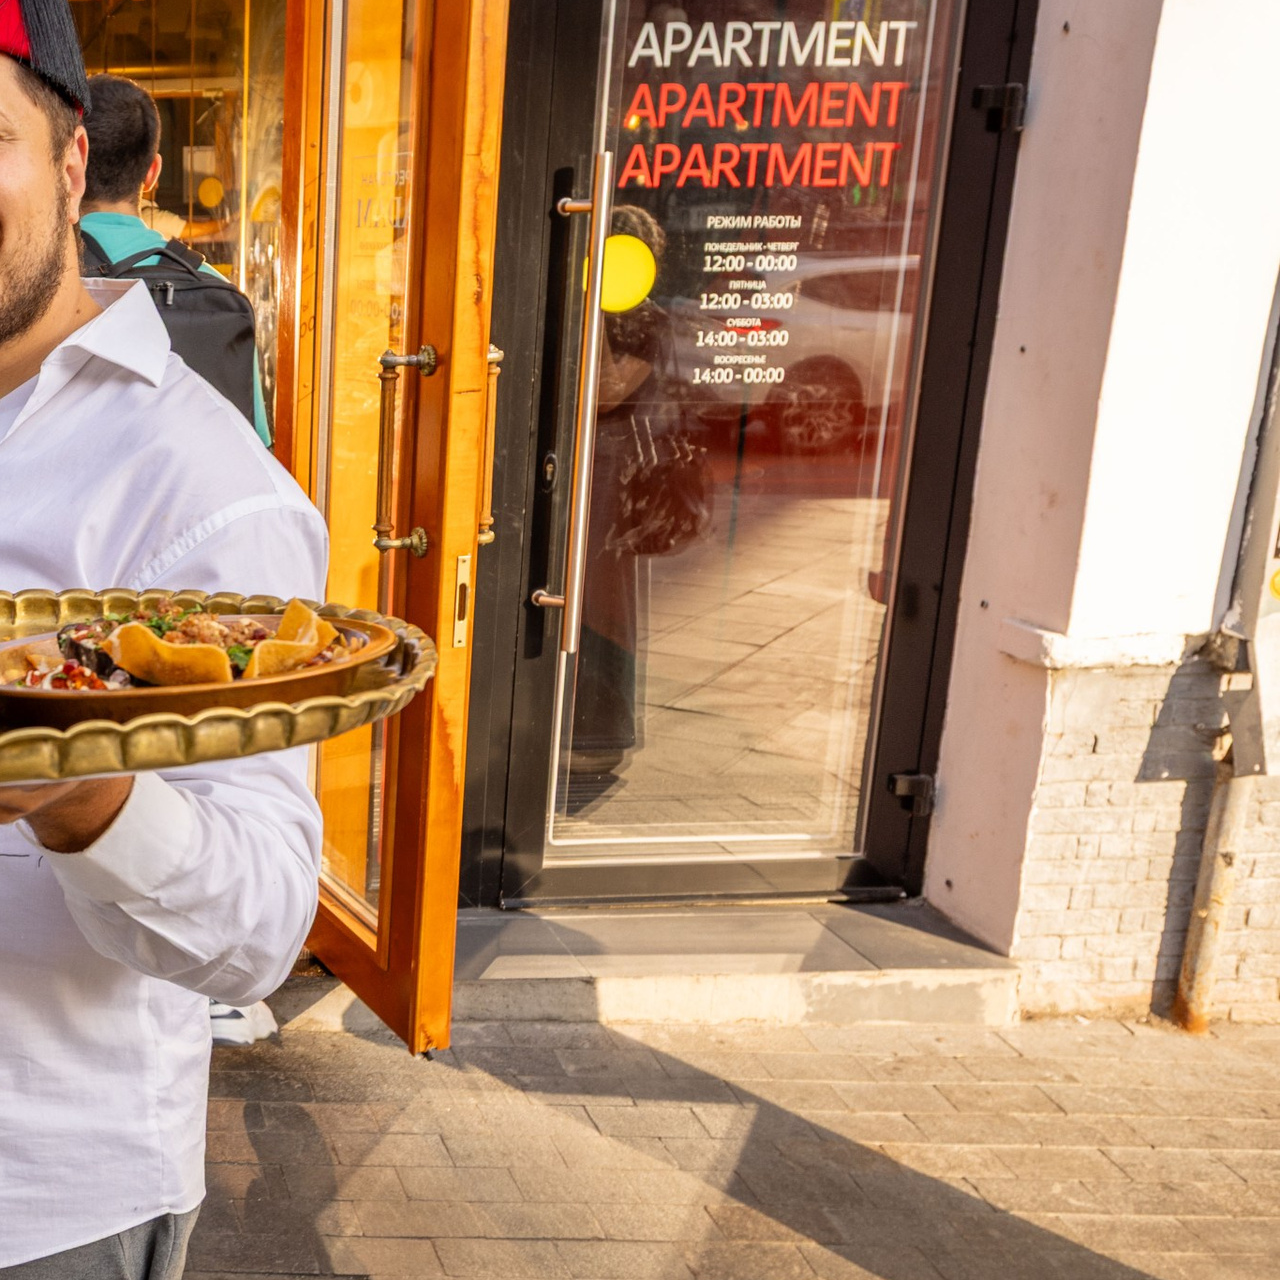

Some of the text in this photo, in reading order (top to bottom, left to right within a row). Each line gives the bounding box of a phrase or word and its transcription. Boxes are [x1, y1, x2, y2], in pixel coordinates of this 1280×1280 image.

[628, 21, 917, 68] APARTMENT
[623, 82, 910, 129] APARTMENT
[618, 142, 902, 189] APARTMENT
[707, 215, 802, 229] РЕЖИМ РАБОТЫ
[704, 242, 762, 252] ПОНЕДЕЛЬНИК
[767, 242, 799, 252] ЧЕТВЕРГ
[703, 255, 745, 272] 12:00
[755, 255, 797, 272] 00:00
[728, 280, 766, 290] ПЯТНИЦА
[699, 293, 741, 309] 12:00
[751, 293, 793, 309] 03:00
[726, 318, 761, 327] СУББОТА
[696, 331, 738, 347] 14:00
[747, 330, 789, 346] 03:00
[713, 355, 766, 364] ВОСКРЕСЕНЬЕ
[692, 368, 734, 384] 14:00
[743, 367, 785, 383] 00:00
